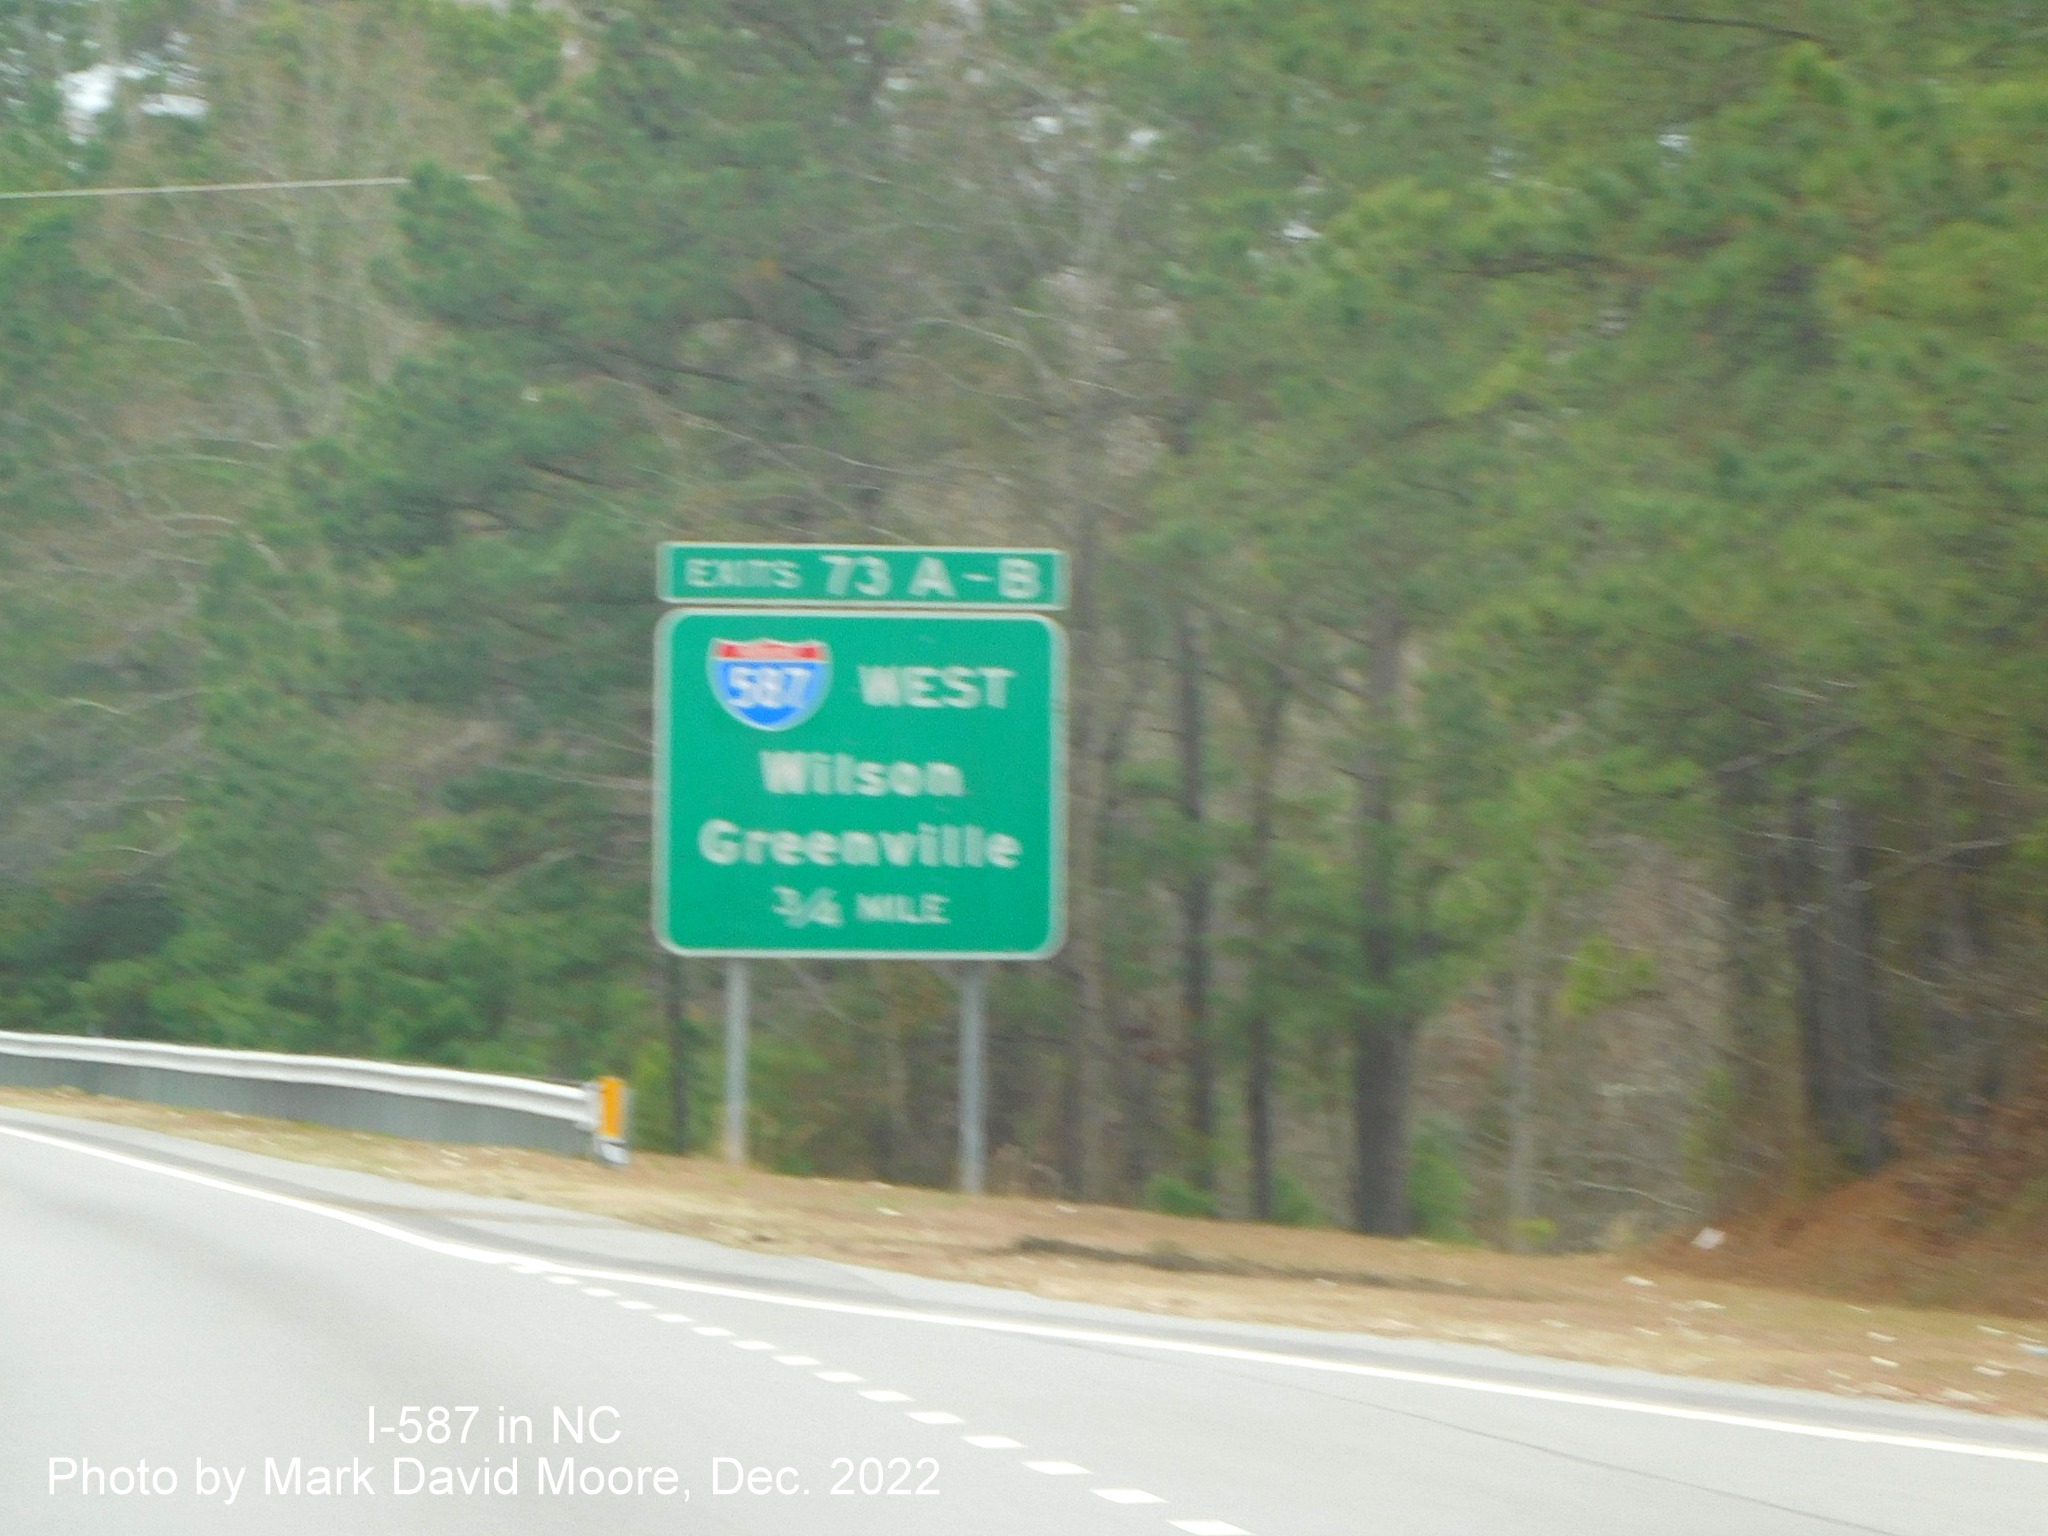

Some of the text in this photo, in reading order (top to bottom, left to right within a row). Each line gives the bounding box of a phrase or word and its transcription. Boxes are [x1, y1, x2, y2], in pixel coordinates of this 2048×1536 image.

[821, 555, 892, 597] 73
[727, 664, 1018, 709] 587 WEST
[759, 750, 967, 797] Wilson
[698, 818, 1023, 869] Greenville
[855, 893, 951, 924] MILE
